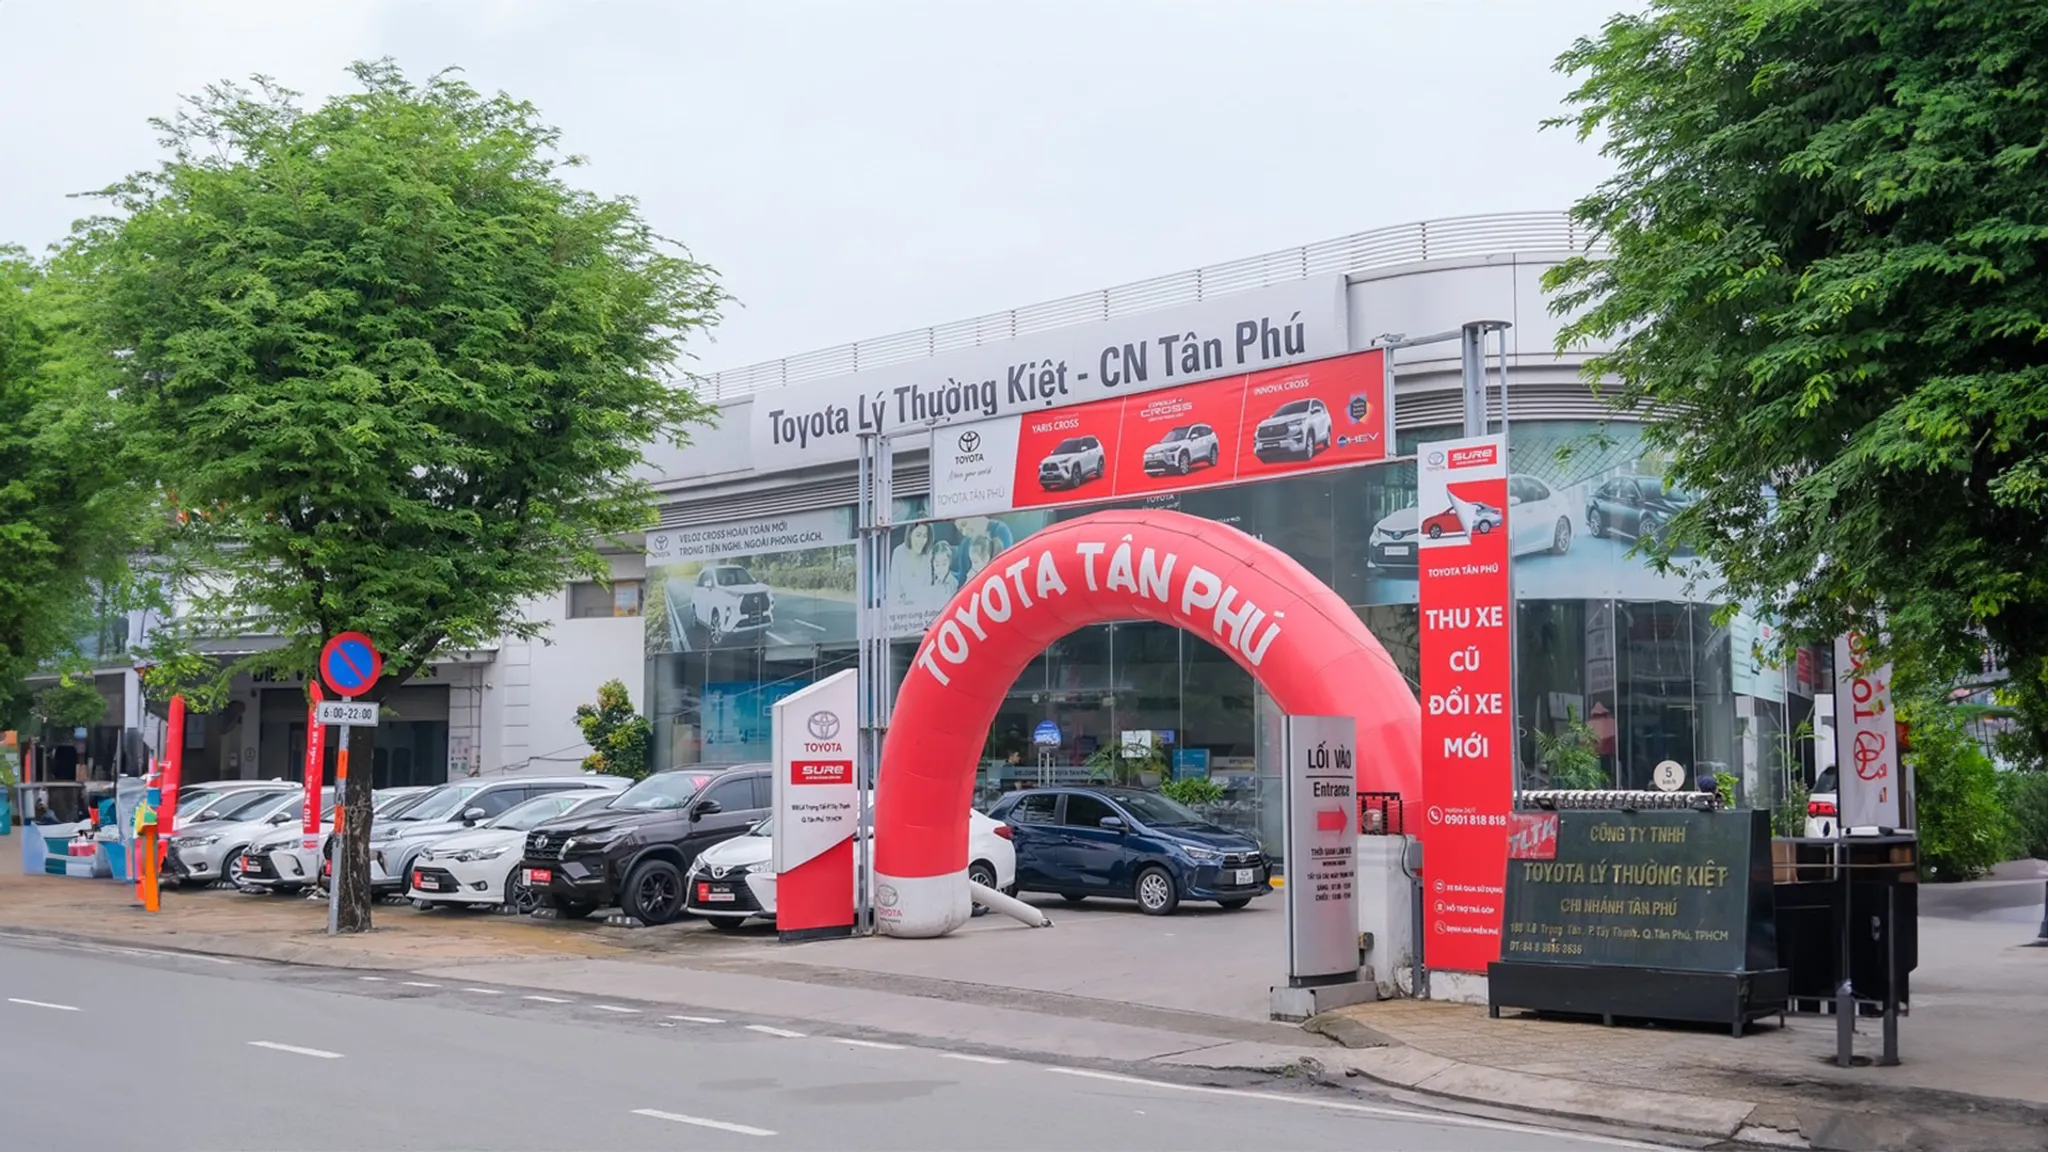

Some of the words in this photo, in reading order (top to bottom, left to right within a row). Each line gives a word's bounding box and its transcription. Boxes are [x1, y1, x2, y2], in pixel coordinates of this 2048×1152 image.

[769, 404, 850, 449] Toyota
[858, 391, 886, 433] Lý
[893, 376, 998, 422] Thường
[1006, 358, 1068, 406] Kiệt
[1100, 340, 1148, 388] CN
[1158, 332, 1223, 377] Tân
[1235, 311, 1305, 365] Phú
[1253, 384, 1284, 396] INNOVA
[1284, 378, 1309, 391] CROSS
[1140, 402, 1192, 417] CROSS
[1032, 422, 1053, 433] YARIS
[1053, 418, 1079, 430] CROSS
[955, 453, 984, 465] TOYOTA
[702, 529, 725, 541] CROSS
[1428, 567, 1460, 577] TOYOTA
[1462, 564, 1479, 575] TÂN
[1480, 562, 1499, 573] PHÚ
[918, 550, 1067, 687] TOYOTA
[1076, 533, 1178, 603] TÂN
[1181, 564, 1285, 667] PHÚ
[1425, 607, 1470, 630] THU
[1476, 606, 1503, 628] XE
[1449, 645, 1480, 672] CŨ
[1428, 686, 1469, 715] ĐỔI
[1475, 693, 1503, 714] XE
[323, 707, 373, 720] 6:00-22:00
[804, 742, 842, 752] TOYOTA
[1443, 731, 1488, 758] MỚI
[1307, 741, 1329, 769] LỐI
[1334, 744, 1352, 769] VÀO
[1665, 766, 1673, 778] 5
[1313, 781, 1350, 798] Entrance
[1444, 815, 1468, 825] 0901
[1469, 815, 1487, 825] 818
[1488, 815, 1507, 826] 818
[1590, 822, 1625, 843] CÔNG
[1629, 825, 1647, 842] TY
[1650, 826, 1686, 843] TNHH
[1523, 862, 1585, 883] TOYOTA
[1590, 859, 1608, 884] LÝ
[1611, 859, 1682, 886] THƯỜNG
[1686, 859, 1729, 895] KIỆT
[1560, 898, 1581, 913] CHI
[1583, 897, 1623, 915] NHÁNH
[1627, 896, 1650, 916] TÂN
[1652, 898, 1678, 916] PHÚ
[1694, 930, 1729, 941] TPHCM
